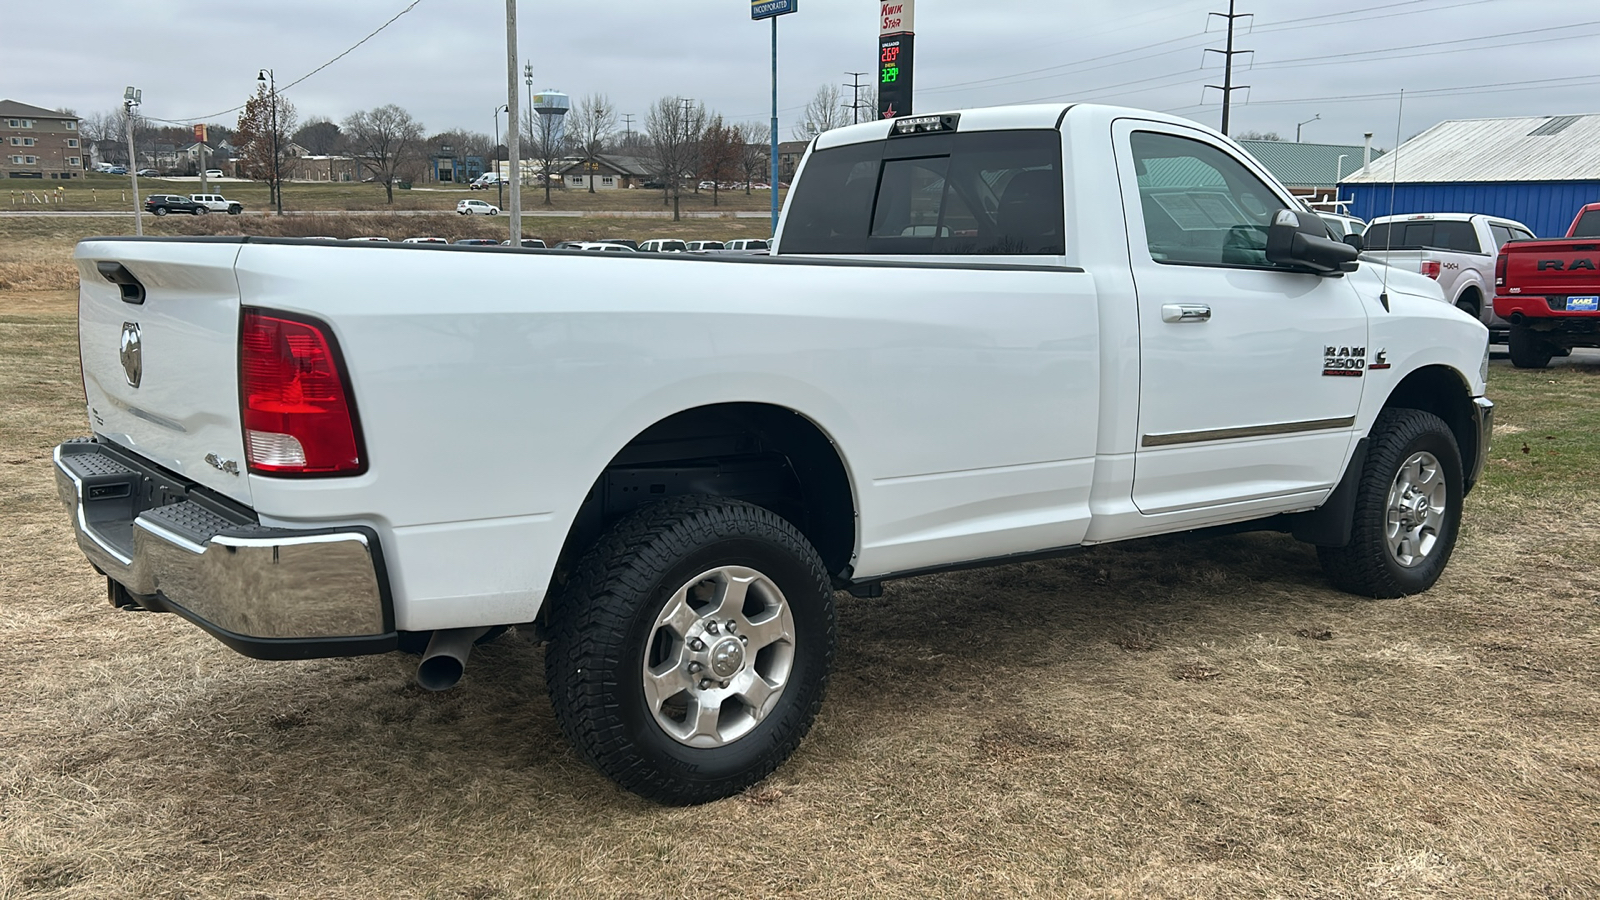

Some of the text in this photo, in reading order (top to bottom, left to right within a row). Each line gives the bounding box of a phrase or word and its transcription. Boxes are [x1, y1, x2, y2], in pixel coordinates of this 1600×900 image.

[753, 1, 787, 14] INCORPORATED
[1537, 258, 1600, 271] RA
[1323, 345, 1366, 357] RAM
[1323, 357, 1365, 370] 2500
